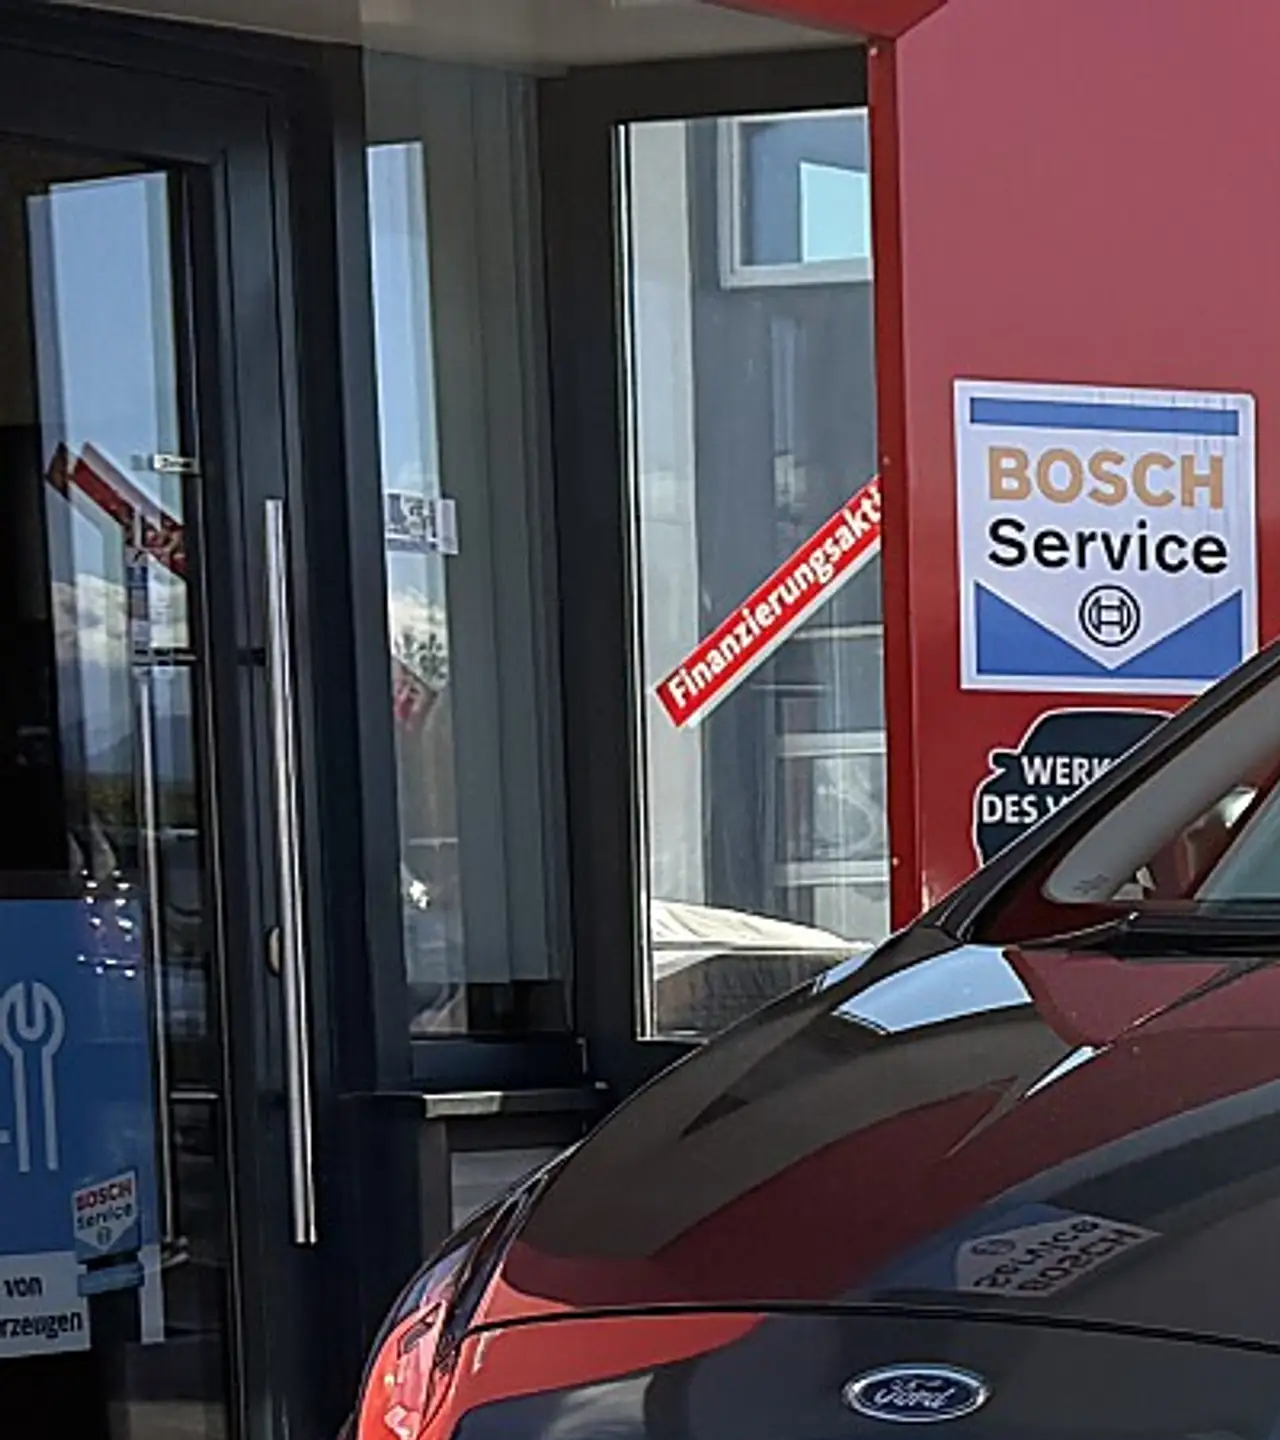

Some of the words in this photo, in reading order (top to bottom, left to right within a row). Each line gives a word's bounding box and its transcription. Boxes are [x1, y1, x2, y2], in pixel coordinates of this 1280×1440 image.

[988, 446, 1224, 510] BOSCH
[988, 517, 1228, 574] Service
[982, 793, 1038, 824] DES
[76, 1177, 132, 1211] BOSCH
[3, 1275, 43, 1298] von
[874, 1379, 956, 1409] Ford
